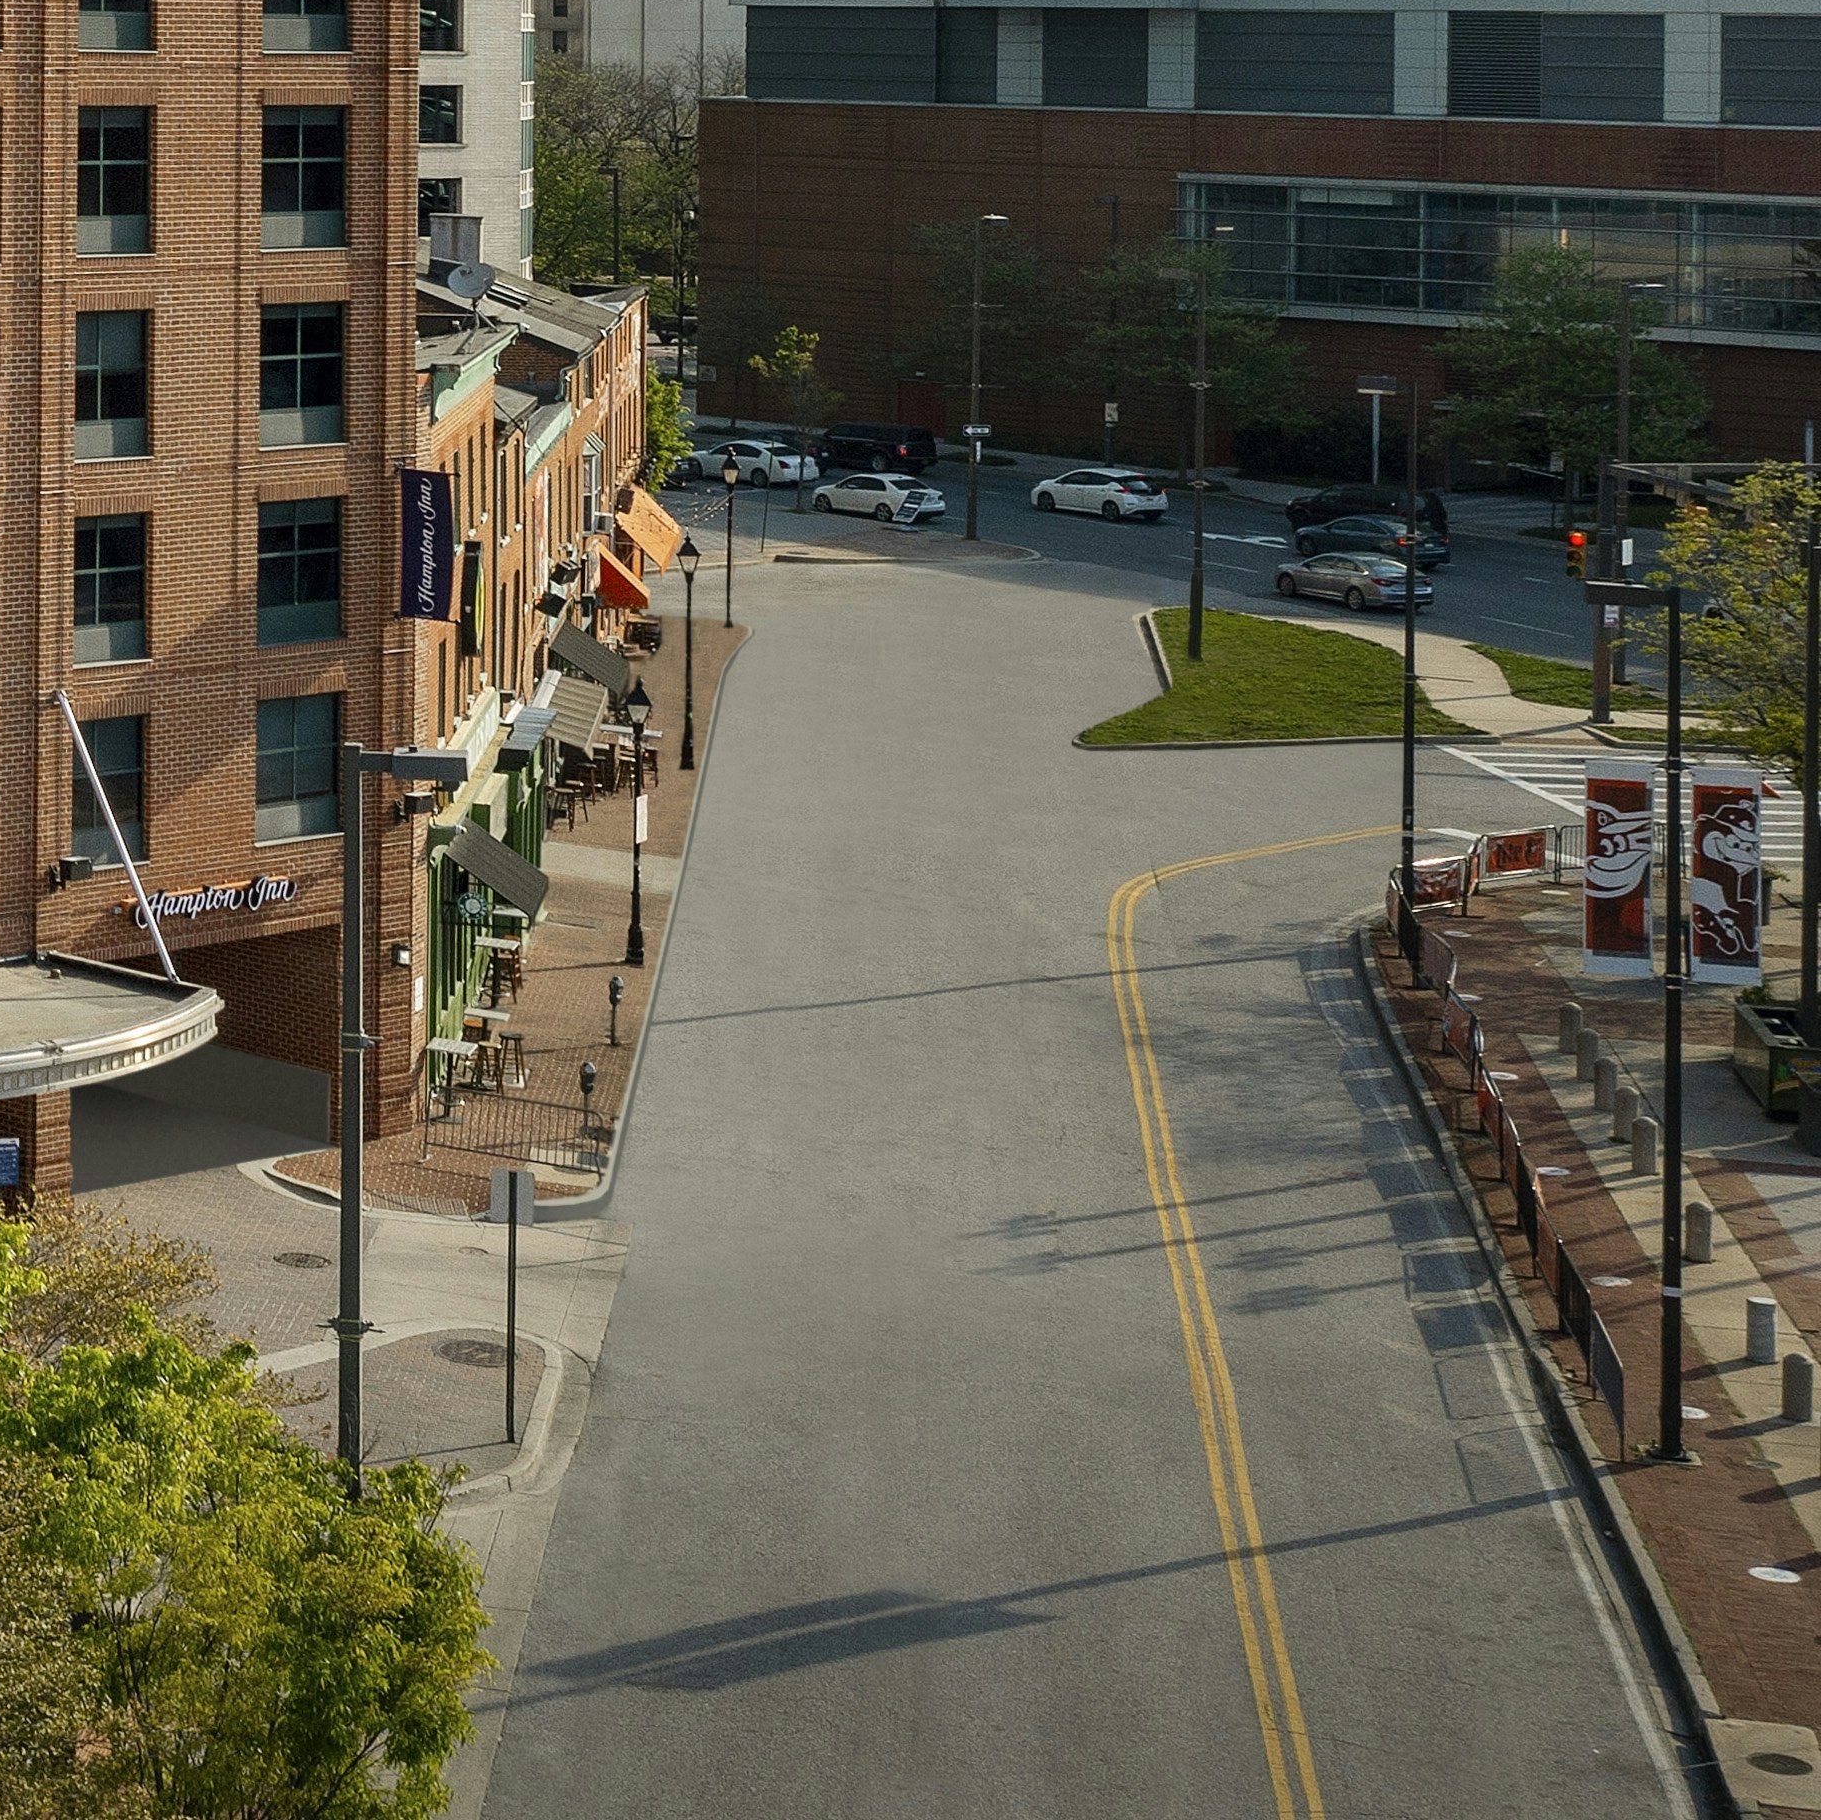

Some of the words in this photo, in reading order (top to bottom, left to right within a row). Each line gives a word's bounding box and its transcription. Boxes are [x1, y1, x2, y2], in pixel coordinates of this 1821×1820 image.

[417, 477, 437, 521] Inn
[417, 521, 437, 613] Hampton
[135, 887, 245, 929] Hampton
[248, 876, 298, 912] Inn
